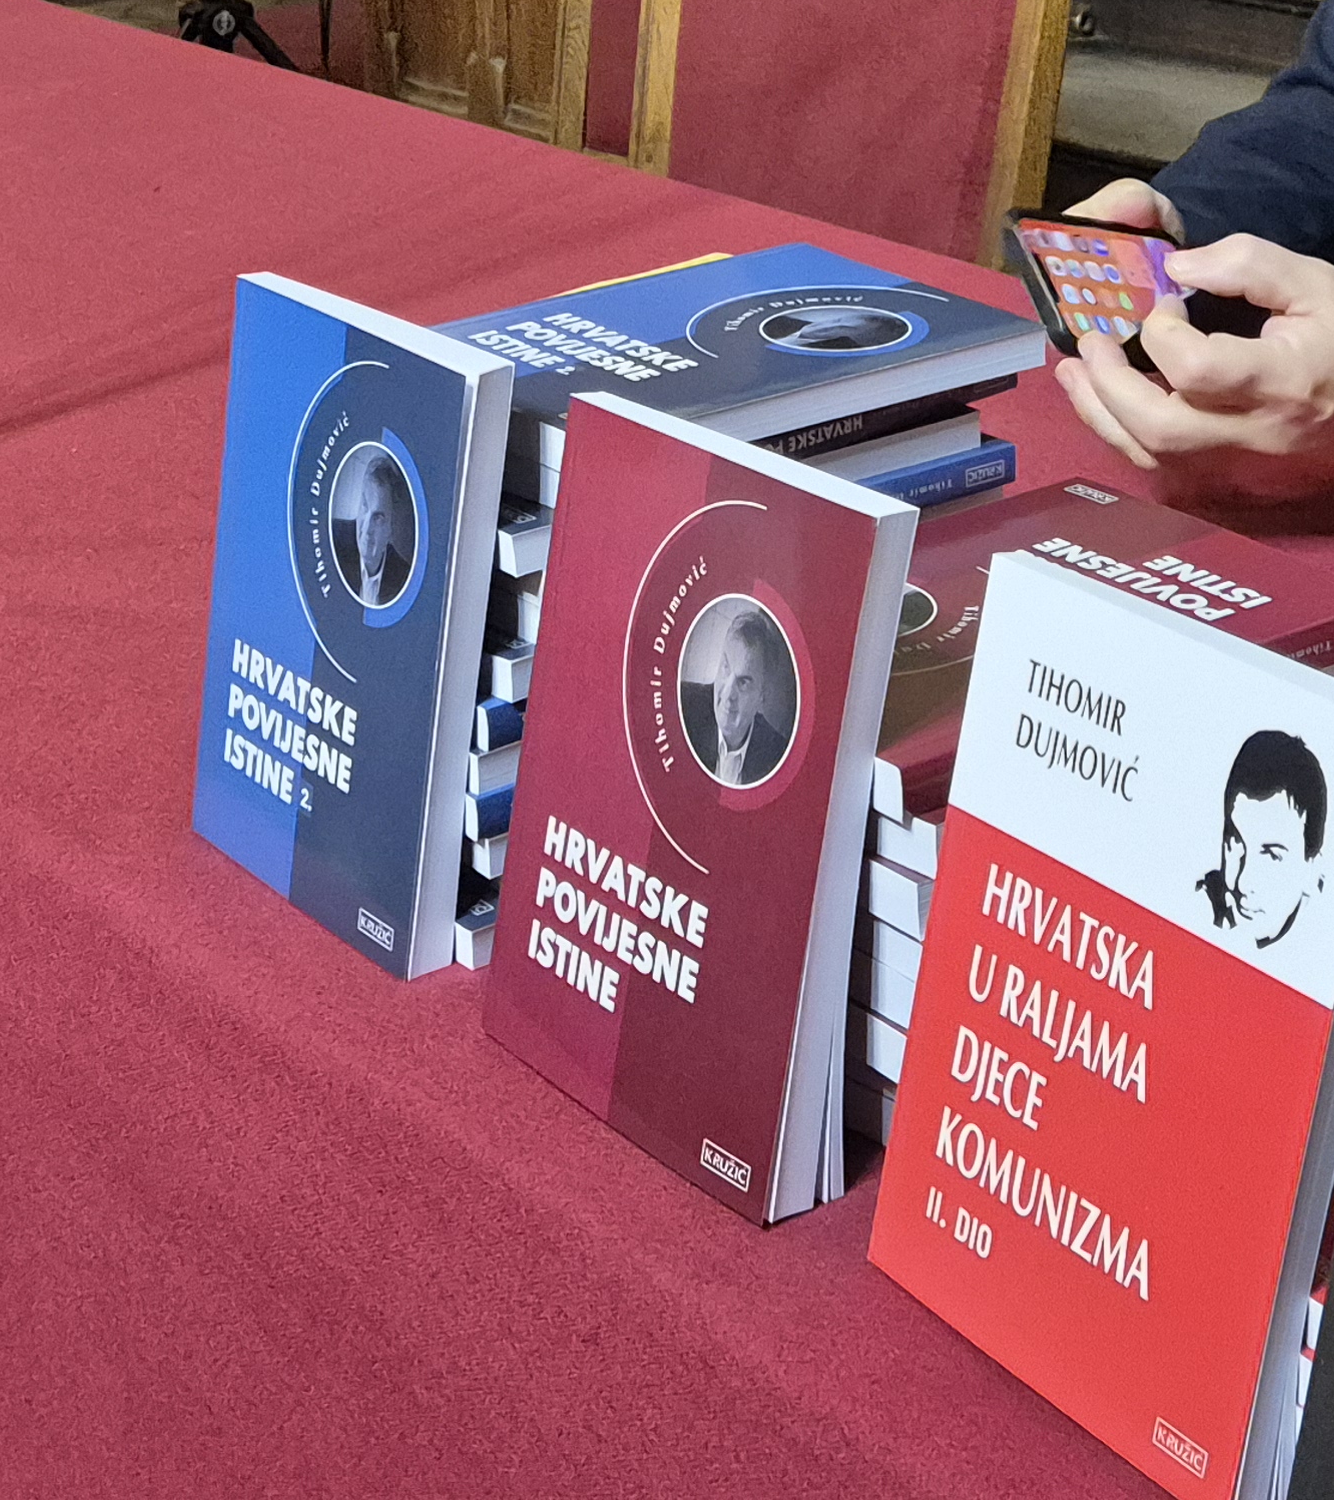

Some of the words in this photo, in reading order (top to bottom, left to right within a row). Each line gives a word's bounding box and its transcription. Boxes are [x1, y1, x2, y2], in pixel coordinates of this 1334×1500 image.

[467, 329, 566, 369] ISTINE
[505, 320, 662, 383] POVIJESNE
[542, 312, 699, 373] HRVATSKE
[310, 410, 350, 497] Dujmović
[787, 415, 864, 453] HRVATSKE
[309, 507, 332, 599] Tihomir
[1031, 537, 1237, 622] POVIJESNE
[1142, 554, 1273, 610] ISTINE
[653, 555, 709, 655] Dujmović
[936, 605, 980, 643] Tihomir
[231, 637, 358, 747] HRVATSKE
[650, 666, 675, 773] Tihomir
[1027, 658, 1127, 737] TIHOMIR
[223, 727, 295, 806] ISTINE
[227, 682, 353, 795] POVIJESNE
[1015, 712, 1140, 803] DUJMOVIĆ
[543, 814, 709, 949] HRVATSKE
[527, 918, 621, 1014] ISTINE
[535, 866, 700, 1004] POVIJESNE
[981, 862, 1155, 1012] HRVATSKA
[968, 943, 998, 1003] U
[999, 963, 1148, 1105] RALJAMA
[950, 1023, 1048, 1131] DJECE
[925, 1185, 947, 1229] II.
[953, 1206, 994, 1260] DIO
[935, 1104, 1150, 1302] KOMUNIZMA
